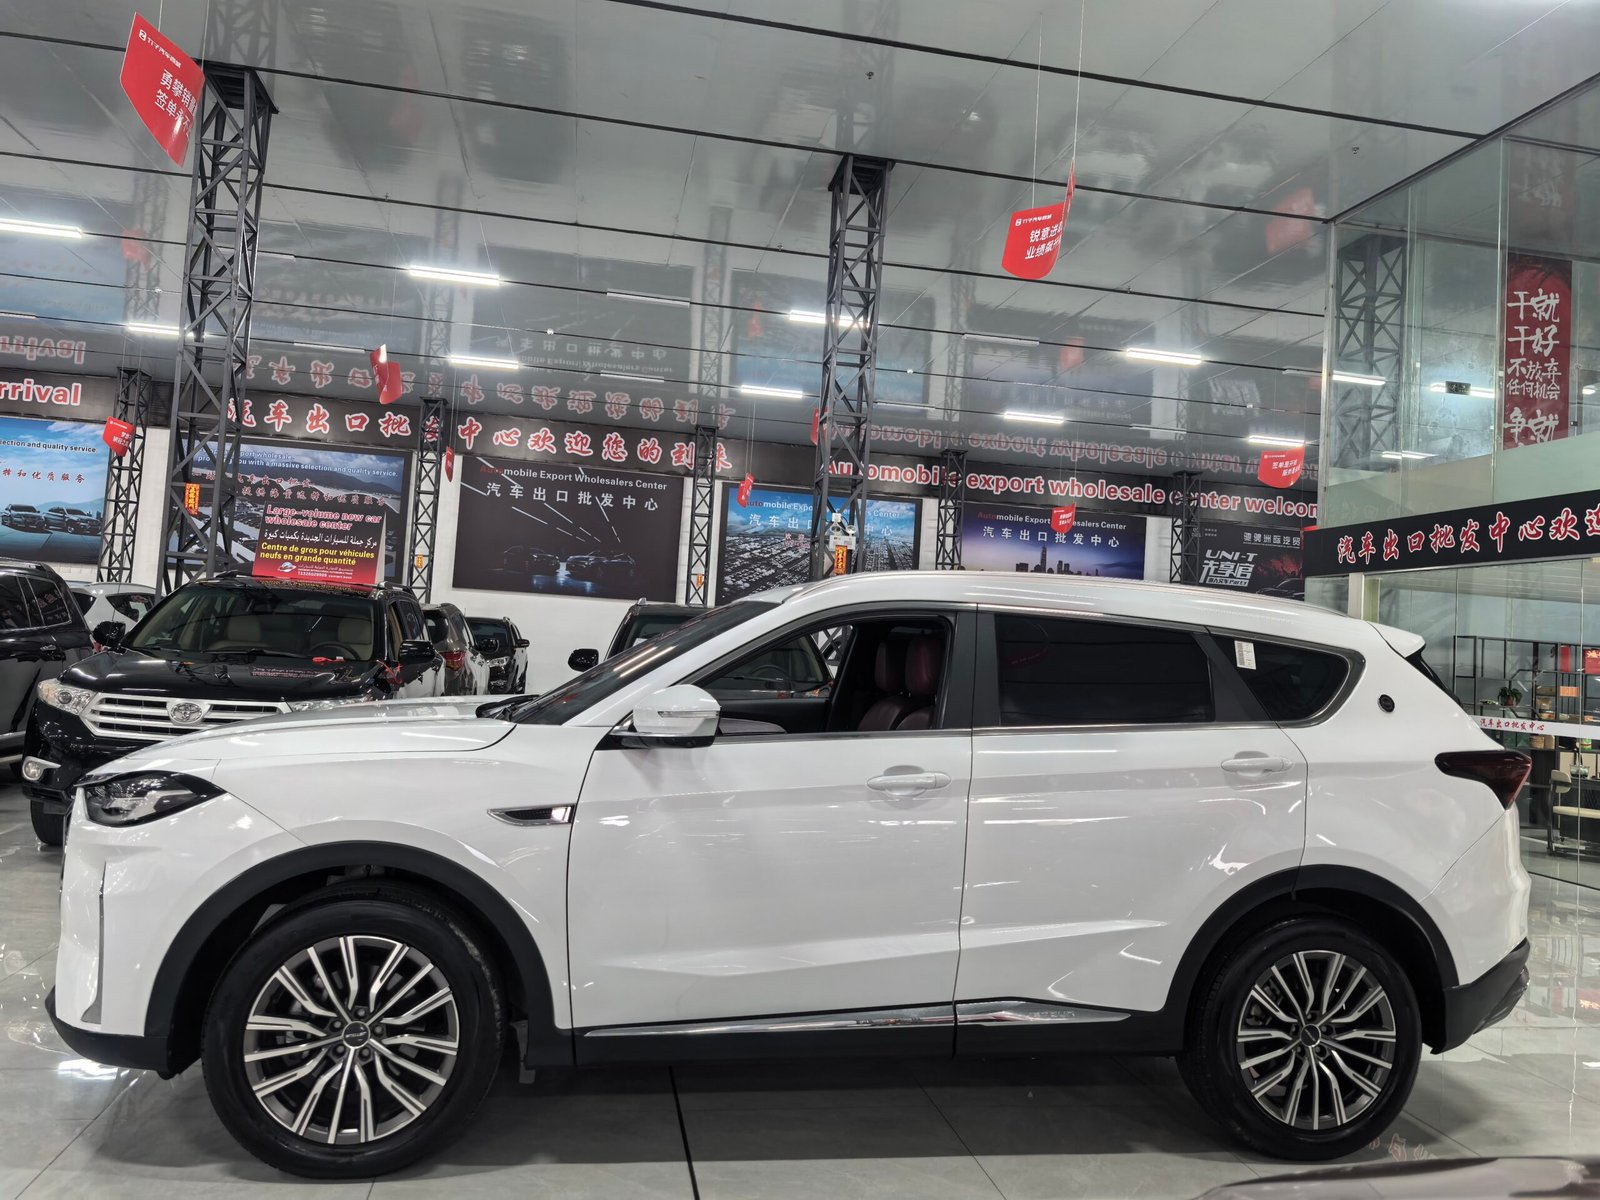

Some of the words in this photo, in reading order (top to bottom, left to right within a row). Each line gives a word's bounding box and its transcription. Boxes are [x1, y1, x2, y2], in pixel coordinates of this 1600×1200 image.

[42, 442, 69, 452] quality
[248, 458, 265, 466] with
[270, 461, 300, 469] massive
[300, 462, 332, 472] selection
[333, 465, 346, 473] and
[347, 467, 371, 476] quality
[539, 470, 573, 483] Export
[574, 473, 634, 488] Wholesalers
[635, 480, 668, 491] Center
[820, 456, 962, 488] Auomobile
[966, 472, 1045, 496] export
[1049, 477, 1166, 505] wholesale
[486, 482, 659, 512] 汽车出口批发中心
[793, 503, 813, 513] Expo
[265, 514, 318, 528] wholesale
[319, 518, 353, 531] center
[341, 511, 364, 522] new
[365, 514, 383, 524] car
[1024, 515, 1051, 526] Export
[1072, 520, 1100, 529] esalers
[1100, 521, 1127, 531] Center
[982, 525, 1120, 548] 汽车出口批发中心
[261, 541, 288, 552] Centre
[289, 543, 299, 553] de
[300, 545, 318, 556] gros
[319, 547, 338, 558] pour
[1205, 549, 1259, 562] UNI-T
[259, 551, 282, 560] neufs
[283, 553, 293, 561] en
[294, 554, 322, 564] grande
[323, 556, 357, 566] quantité
[1480, 718, 1545, 731] 汽车出口批发中心
